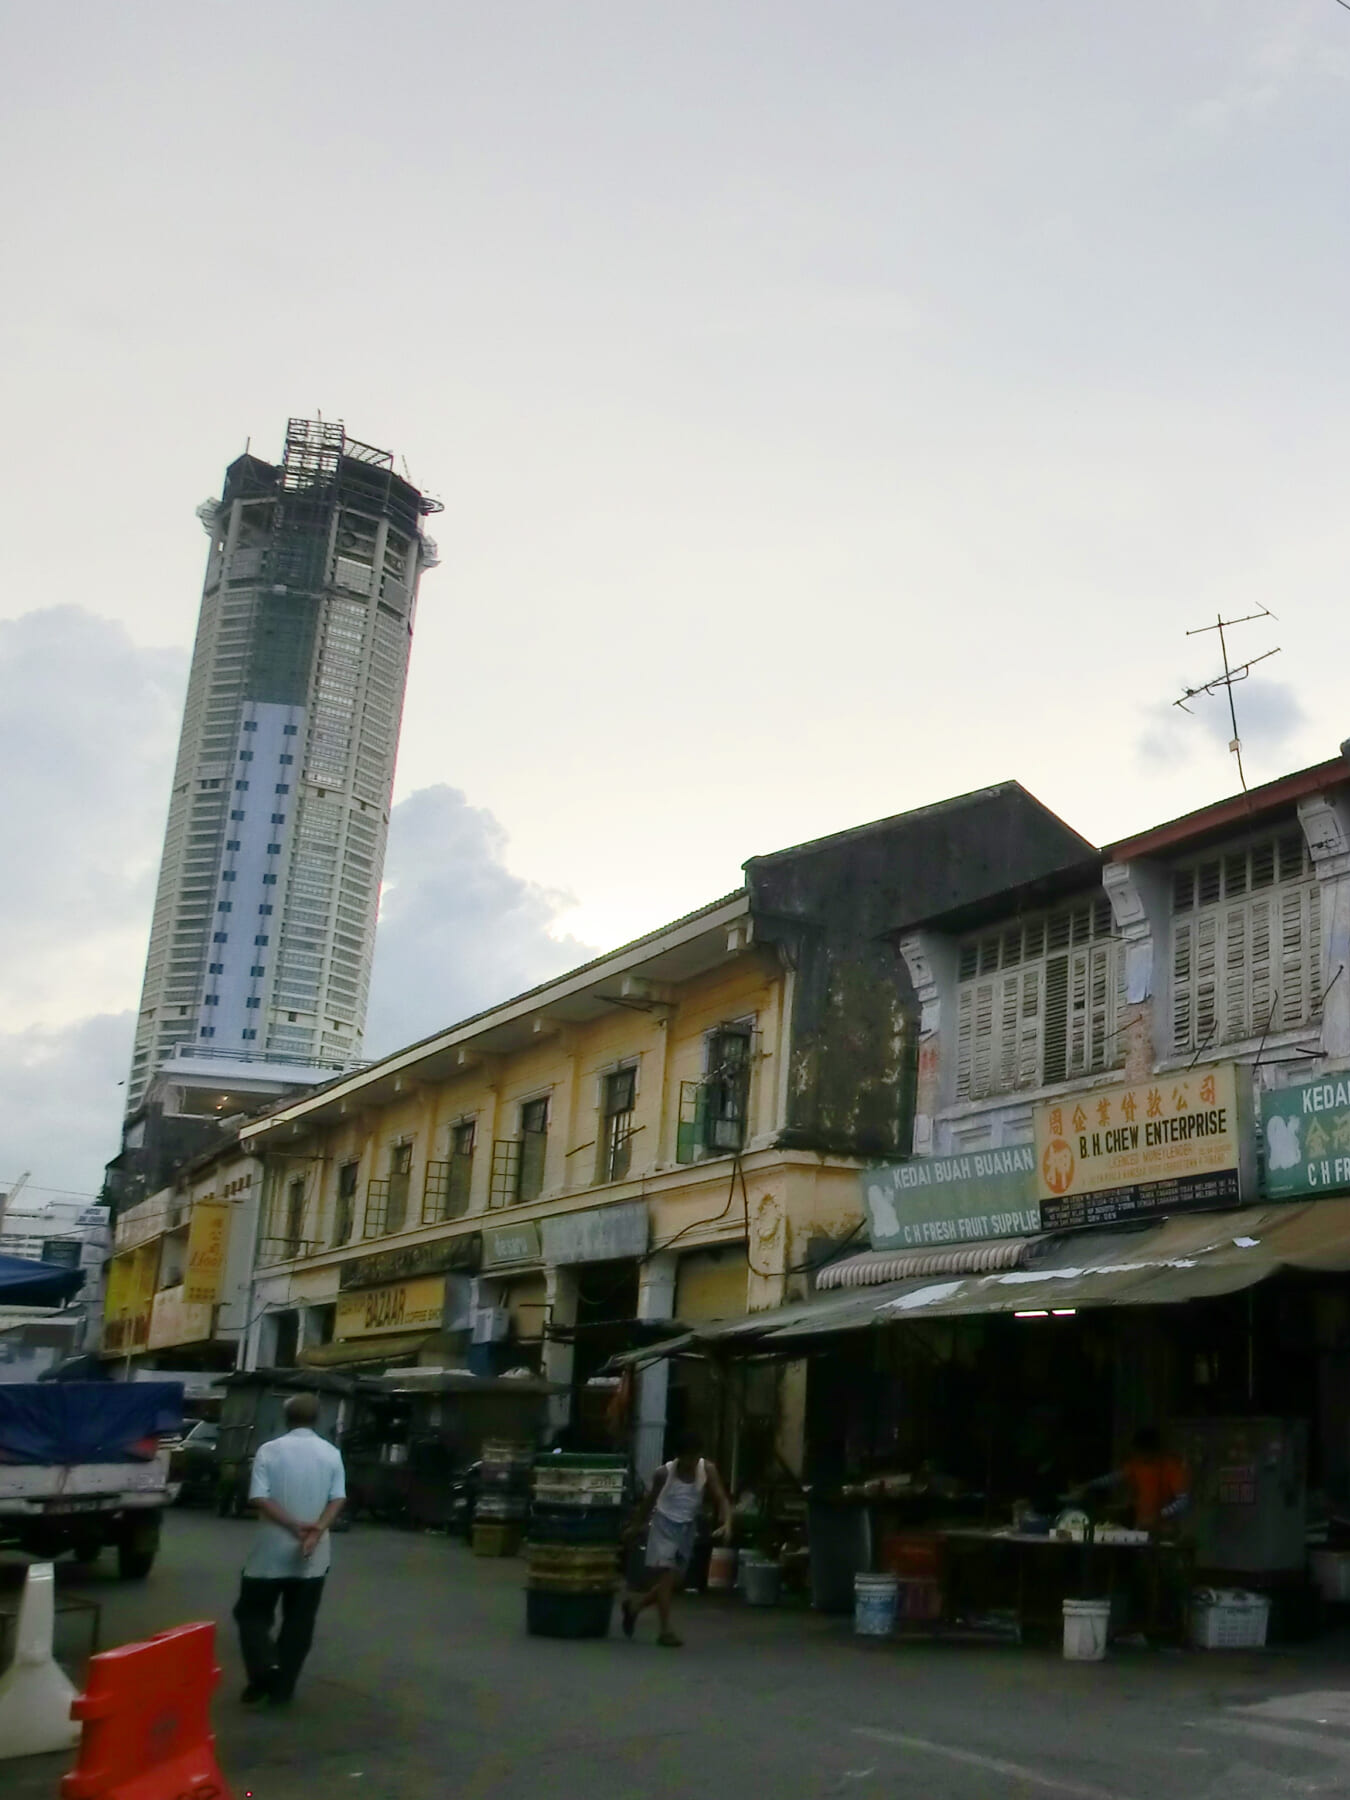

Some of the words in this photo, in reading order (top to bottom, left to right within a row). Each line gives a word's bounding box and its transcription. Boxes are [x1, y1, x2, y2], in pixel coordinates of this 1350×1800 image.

[1079, 1136, 1090, 1159] B.
[1092, 1133, 1103, 1157] H.
[1105, 1126, 1139, 1154] CHEW
[1145, 1108, 1227, 1146] ENTERPRISE
[893, 1166, 932, 1190] KEDAI
[935, 1158, 972, 1183] BUAH
[975, 1148, 1034, 1178] BUAHAN
[1307, 1163, 1317, 1187] C
[1321, 1161, 1330, 1185] H
[904, 1225, 912, 1243] C
[913, 1224, 922, 1243] H
[923, 1220, 955, 1241] FRESH
[958, 1216, 989, 1238] FRUIT
